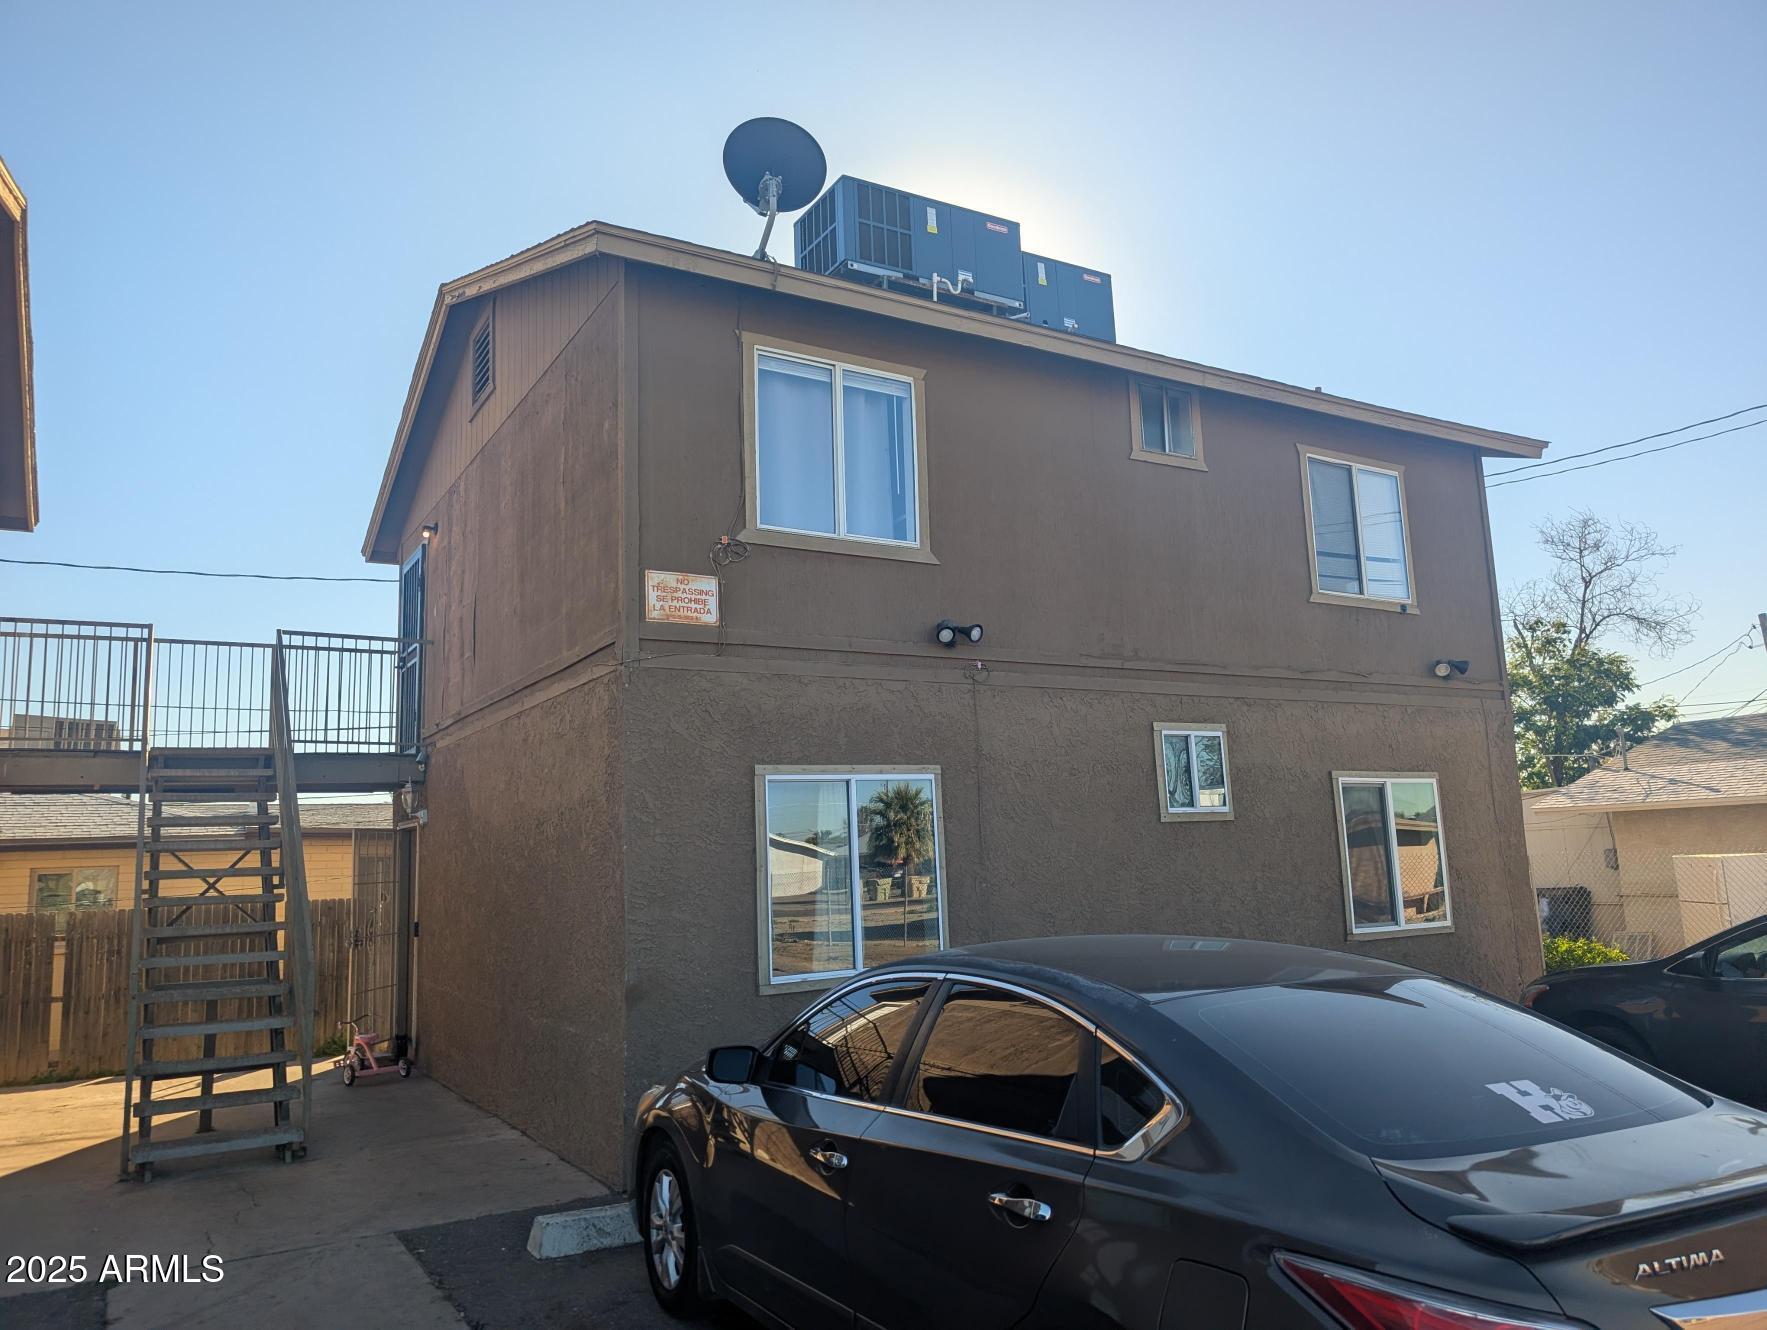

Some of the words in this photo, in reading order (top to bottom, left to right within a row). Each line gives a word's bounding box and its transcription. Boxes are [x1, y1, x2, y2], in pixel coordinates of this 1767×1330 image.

[651, 585, 714, 597] TRESPASSING
[670, 596, 709, 606] PROHIBE
[653, 604, 665, 612] LA
[668, 605, 712, 615] ENTRADA
[1635, 1249, 1725, 1281] ALTIMA
